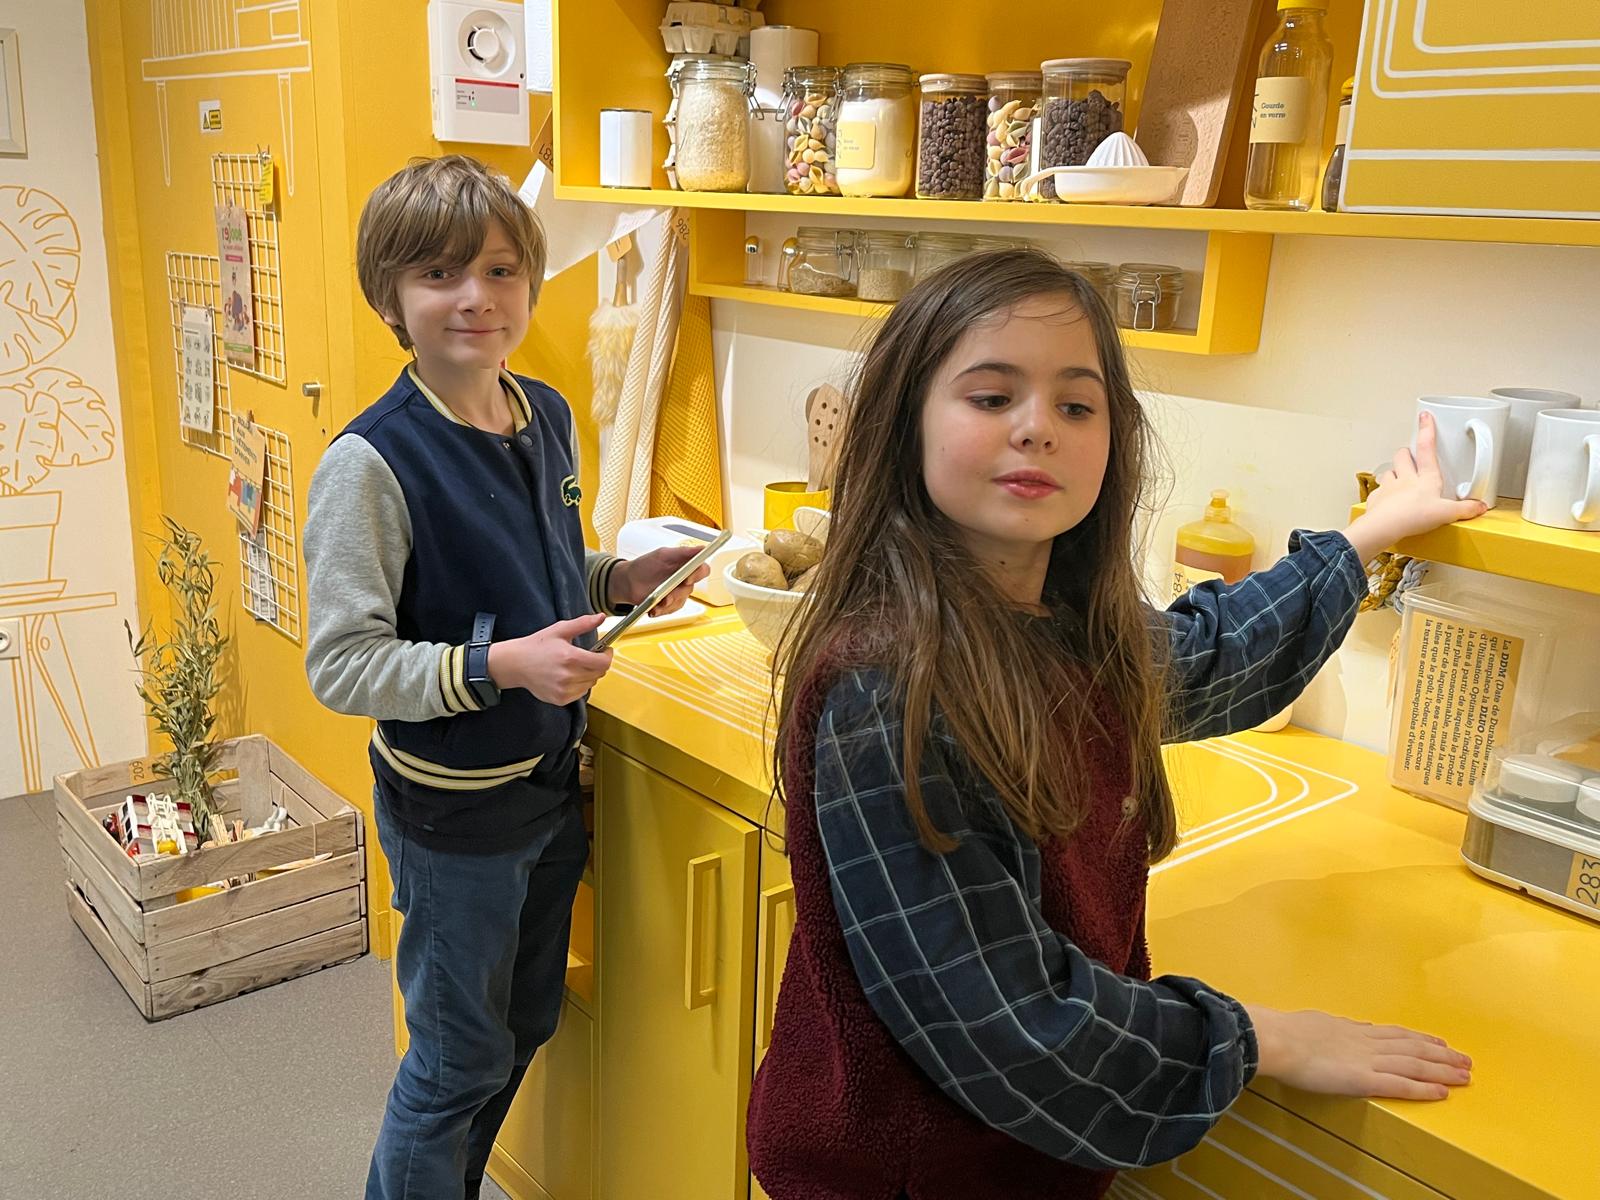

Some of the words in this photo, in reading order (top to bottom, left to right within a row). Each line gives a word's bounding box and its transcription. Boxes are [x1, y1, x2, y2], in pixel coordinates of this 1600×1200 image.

[1425, 618, 1434, 627] la
[1433, 621, 1443, 645] telles
[1420, 628, 1431, 659] texture
[1442, 630, 1452, 656] partir
[1455, 627, 1465, 648] n'est
[1468, 630, 1478, 639] la
[1489, 636, 1498, 652] qui
[1502, 639, 1512, 650] La
[1430, 646, 1439, 663] que
[1452, 648, 1462, 668] plus
[1465, 640, 1475, 660] date
[1472, 633, 1488, 684] d'Utilisation
[1417, 659, 1425, 678] sont
[1429, 663, 1438, 673] le
[1440, 657, 1449, 669] de
[1482, 652, 1495, 694] remplace
[1497, 651, 1510, 679] DDM
[1435, 669, 1448, 704] laquelle
[1459, 667, 1469, 694] partir
[1493, 679, 1505, 703] (Date
[1409, 678, 1423, 730] susceptibles
[1457, 694, 1466, 707] de
[1464, 686, 1480, 729] Optimale)
[1481, 694, 1490, 704] la
[1433, 704, 1441, 720] ses
[1476, 704, 1488, 733] DLUO
[1491, 704, 1500, 716] de
[1418, 729, 1426, 741] ou
[1451, 707, 1465, 743] laquelle
[1439, 730, 1448, 752] mais
[1450, 743, 1459, 753] le
[1459, 729, 1472, 770] n'indique
[1472, 734, 1483, 758] (Date
[1414, 741, 1424, 771] encore
[1423, 720, 1438, 786] caractéristiques
[1437, 752, 1447, 761] la
[132, 761, 144, 781] 209
[1434, 762, 1445, 781] date
[1445, 753, 1456, 786] produit
[1456, 770, 1465, 787] pas
[1468, 758, 1480, 786] Limite
